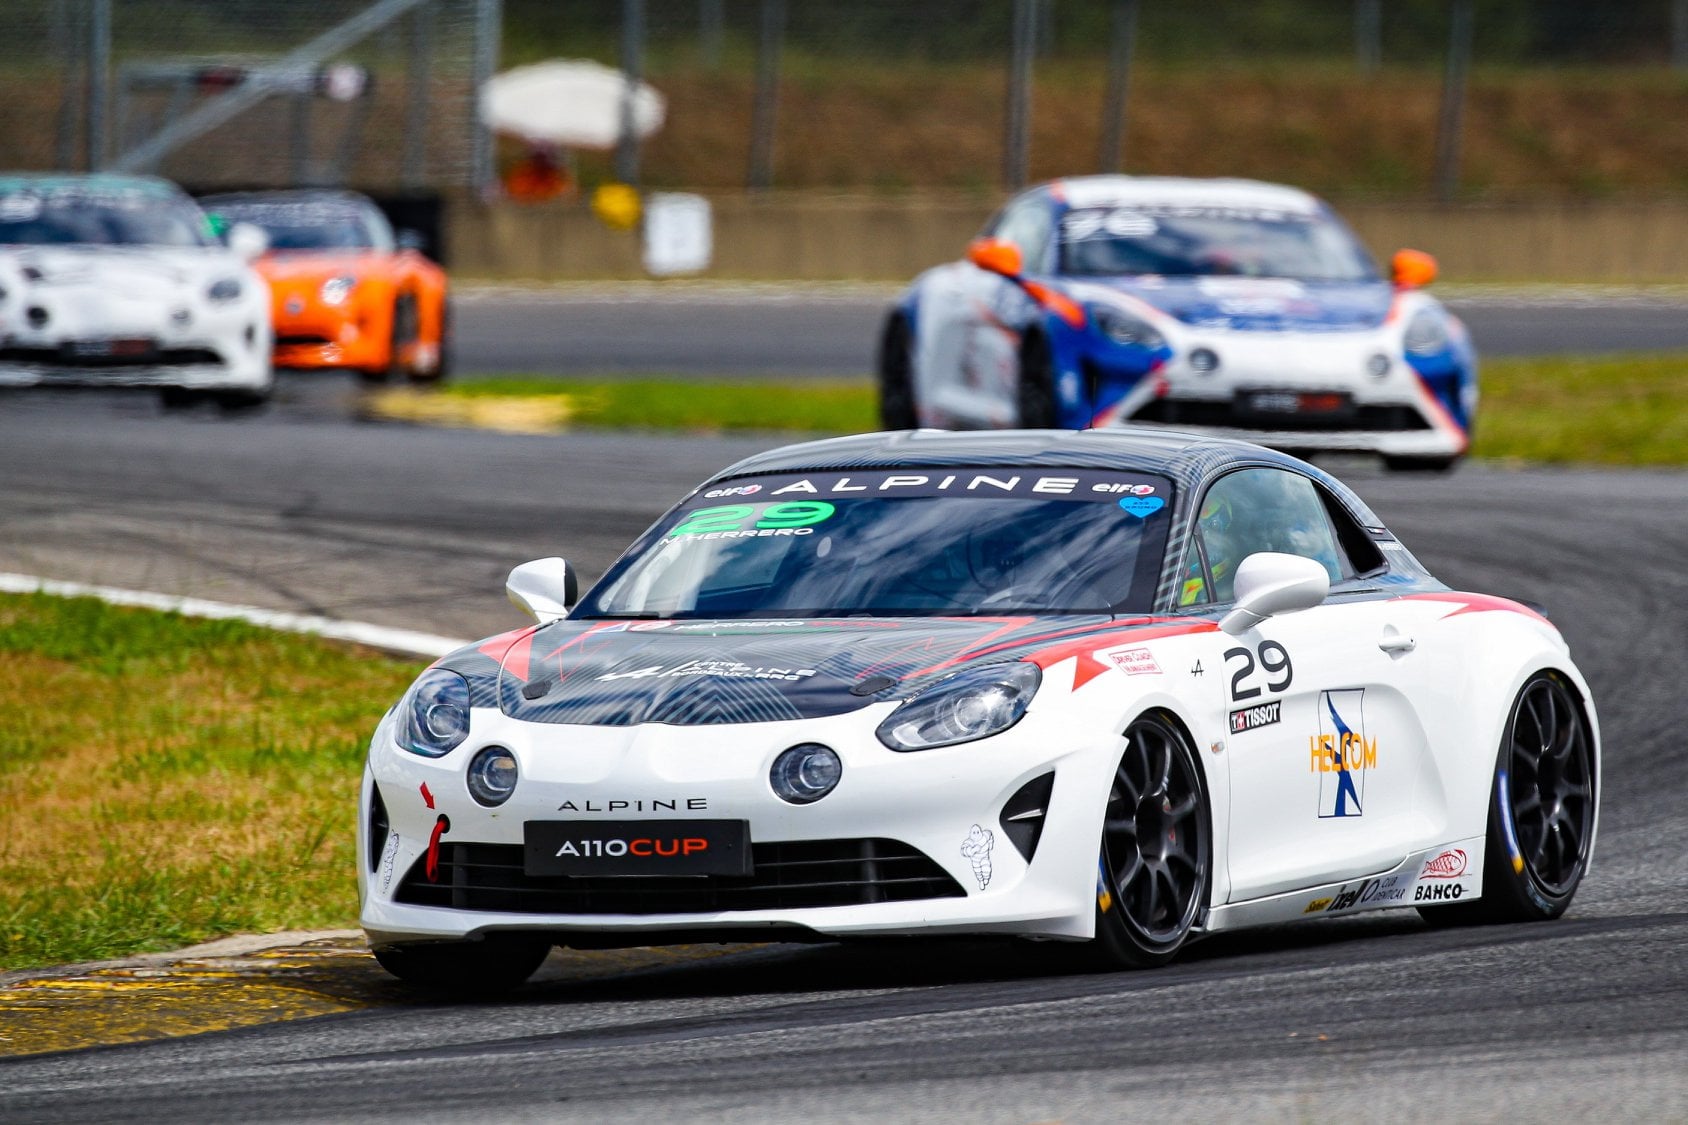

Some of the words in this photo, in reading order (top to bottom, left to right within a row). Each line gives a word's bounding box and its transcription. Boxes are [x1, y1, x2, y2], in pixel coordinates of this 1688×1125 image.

[704, 485, 742, 498] elf
[770, 476, 1079, 495] ALPINE
[1091, 483, 1133, 493] elf
[670, 501, 836, 537] 29
[1223, 639, 1294, 702] 29
[1309, 732, 1377, 773] HELCOM
[557, 798, 708, 812] ALPINE
[1414, 883, 1463, 901] BAHCO
